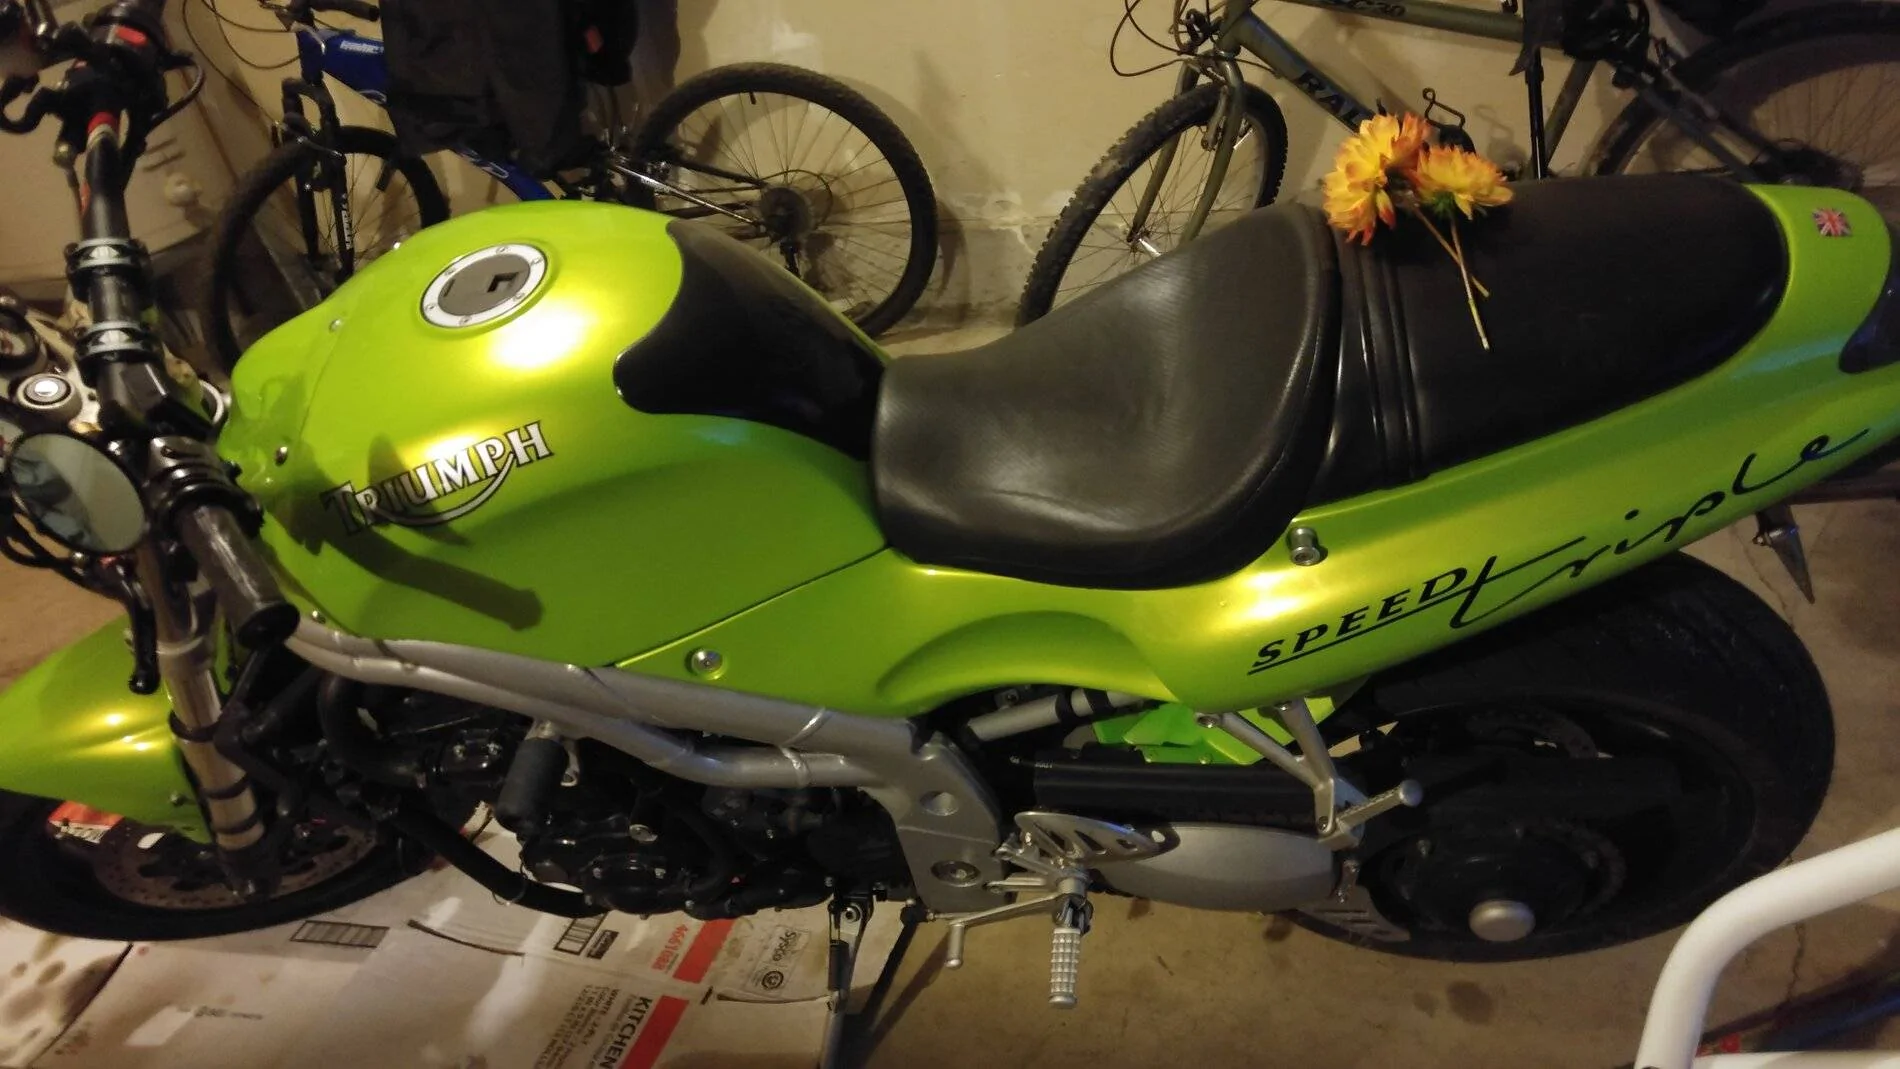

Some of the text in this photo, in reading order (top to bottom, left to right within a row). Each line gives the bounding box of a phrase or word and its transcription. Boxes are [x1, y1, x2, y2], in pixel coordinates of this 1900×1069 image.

[320, 420, 554, 535] TRIUMPH
[1251, 428, 1869, 669] SPEED triple
[772, 930, 797, 962] Sysco
[599, 996, 653, 1069] KITCHEN
